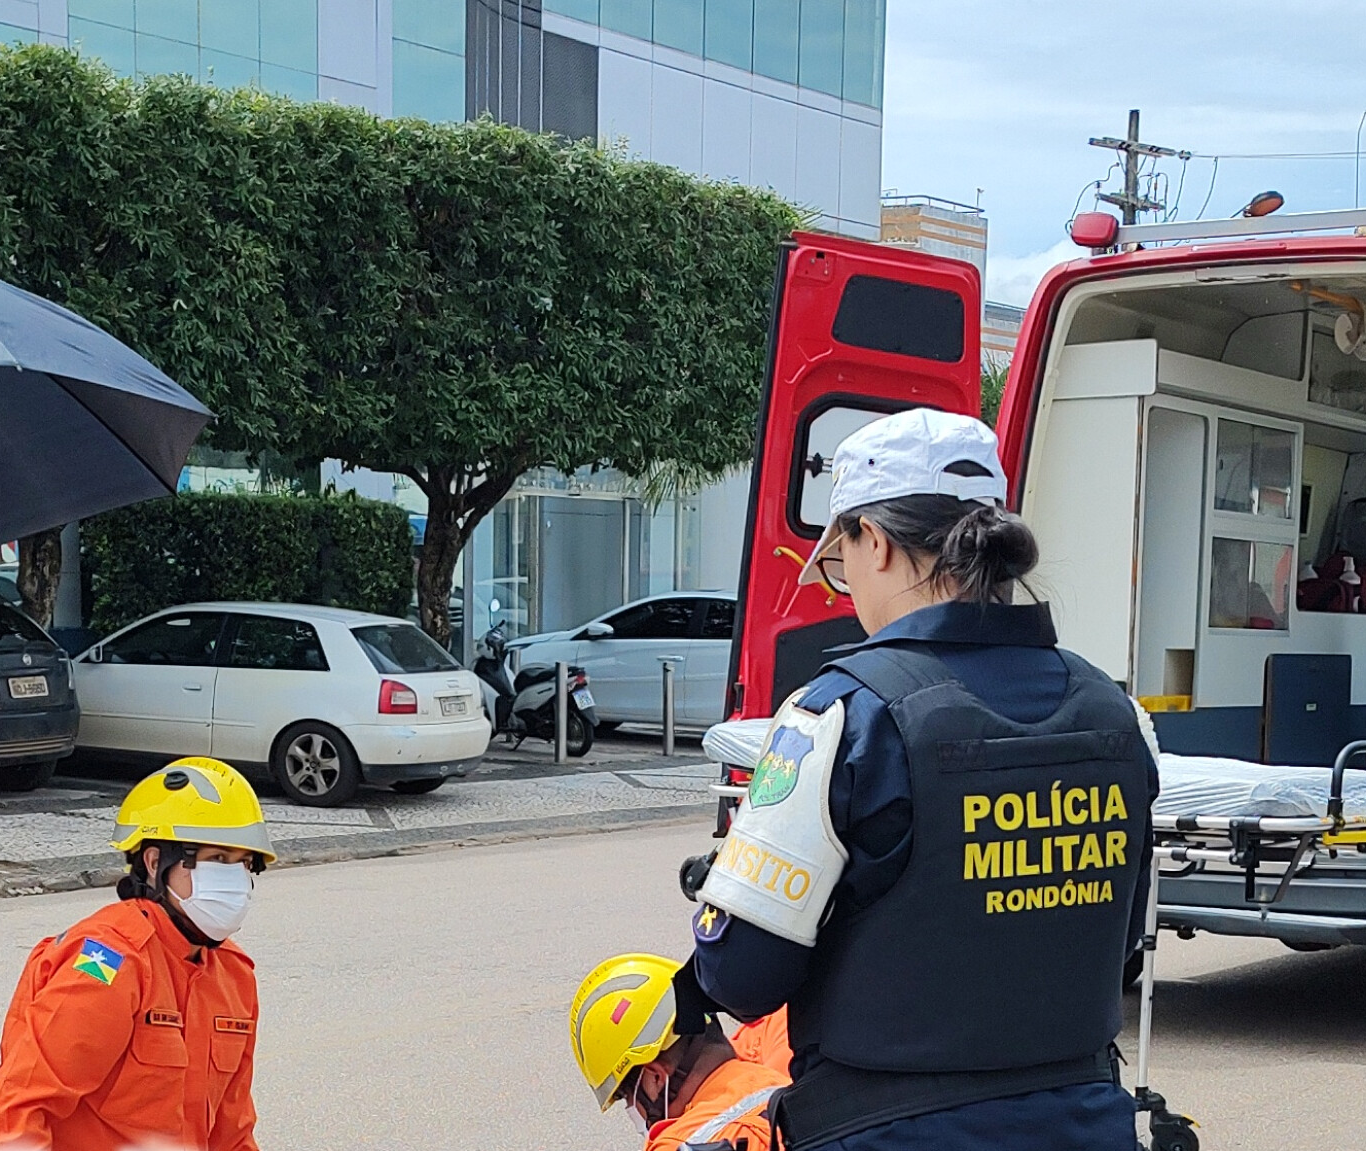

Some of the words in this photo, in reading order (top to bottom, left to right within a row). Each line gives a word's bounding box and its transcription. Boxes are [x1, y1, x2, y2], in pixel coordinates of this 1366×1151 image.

[963, 780, 1128, 833] POLÍCIA
[963, 830, 1128, 880] MILITAR
[986, 878, 1114, 914] RONDÔNIA
